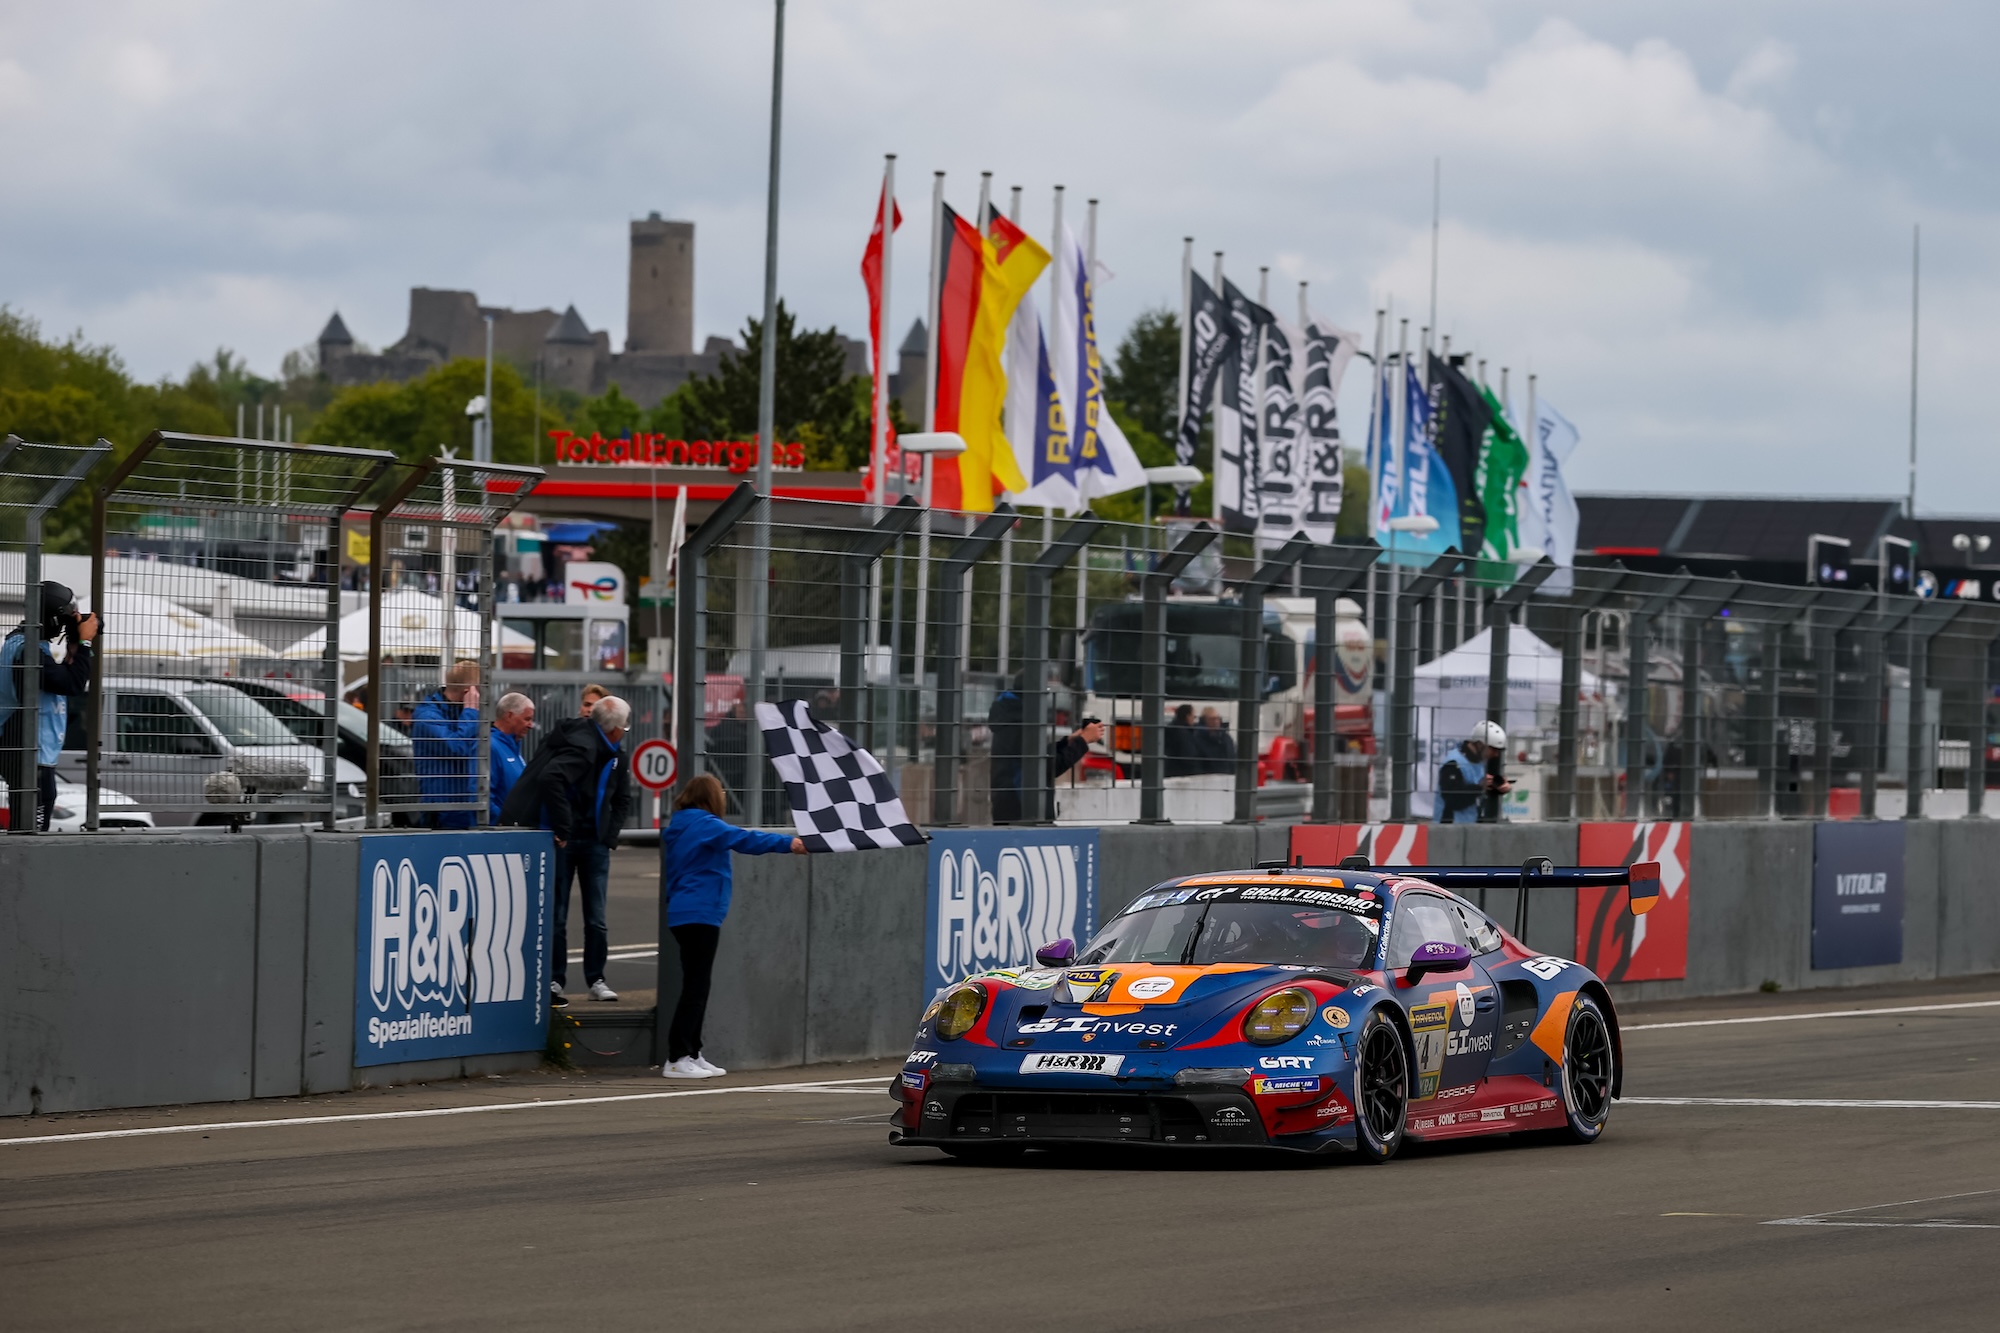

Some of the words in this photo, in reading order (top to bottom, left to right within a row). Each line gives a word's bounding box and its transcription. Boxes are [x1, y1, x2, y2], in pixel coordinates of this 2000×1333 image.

[547, 430, 805, 474] TotalEnergies
[1263, 402, 1299, 526] H&R
[1304, 402, 1341, 523] H&R
[1376, 461, 1398, 533] FAL
[646, 753, 668, 778] 10
[937, 848, 1032, 984] H&R
[1241, 887, 1295, 897] GRAN
[1296, 889, 1376, 909] TURISMO
[1316, 900, 1365, 914] SIMULATOR
[370, 857, 475, 1012] H&R
[534, 851, 547, 1026] www.h-r.com
[1378, 911, 1392, 960] CarCollection.de
[368, 1011, 472, 1049] Spezialfedern
[1446, 1029, 1493, 1056] GInvest
[1259, 1056, 1315, 1069] GRT
[1274, 1081, 1314, 1089] MICHELIN
[1437, 1085, 1476, 1100] PORSCHE
[1438, 1113, 1456, 1125] SONIC
